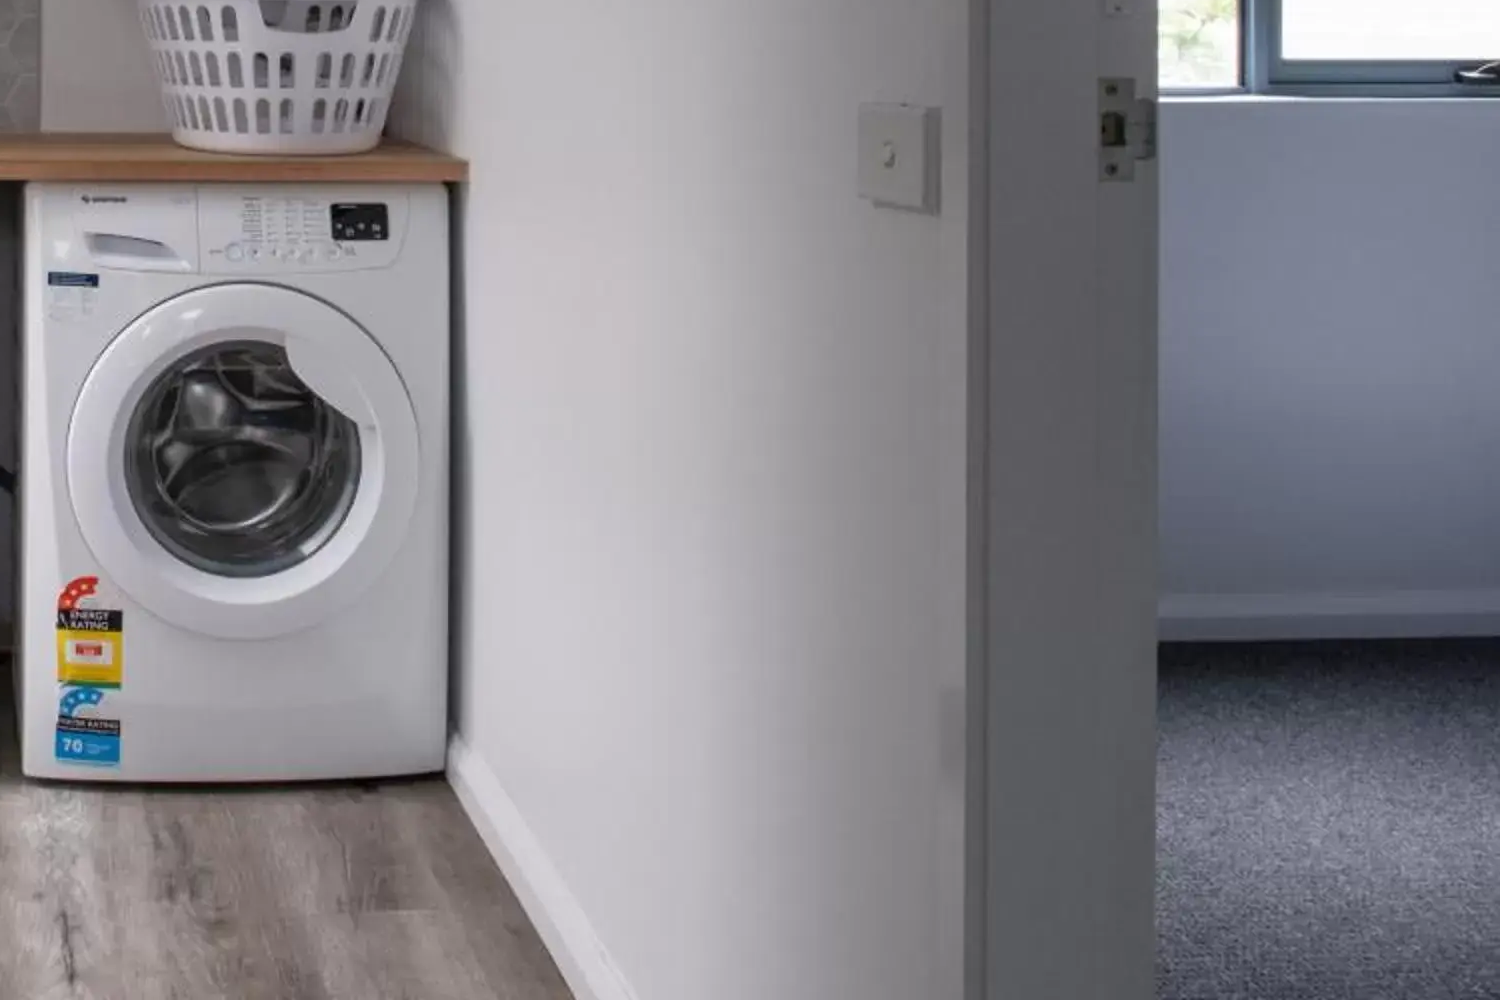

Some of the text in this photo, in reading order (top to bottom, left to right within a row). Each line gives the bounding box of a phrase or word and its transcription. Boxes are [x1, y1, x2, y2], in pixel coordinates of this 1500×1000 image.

[70, 611, 109, 620] ENERGY
[70, 621, 109, 630] RATING
[62, 738, 83, 753] 70
